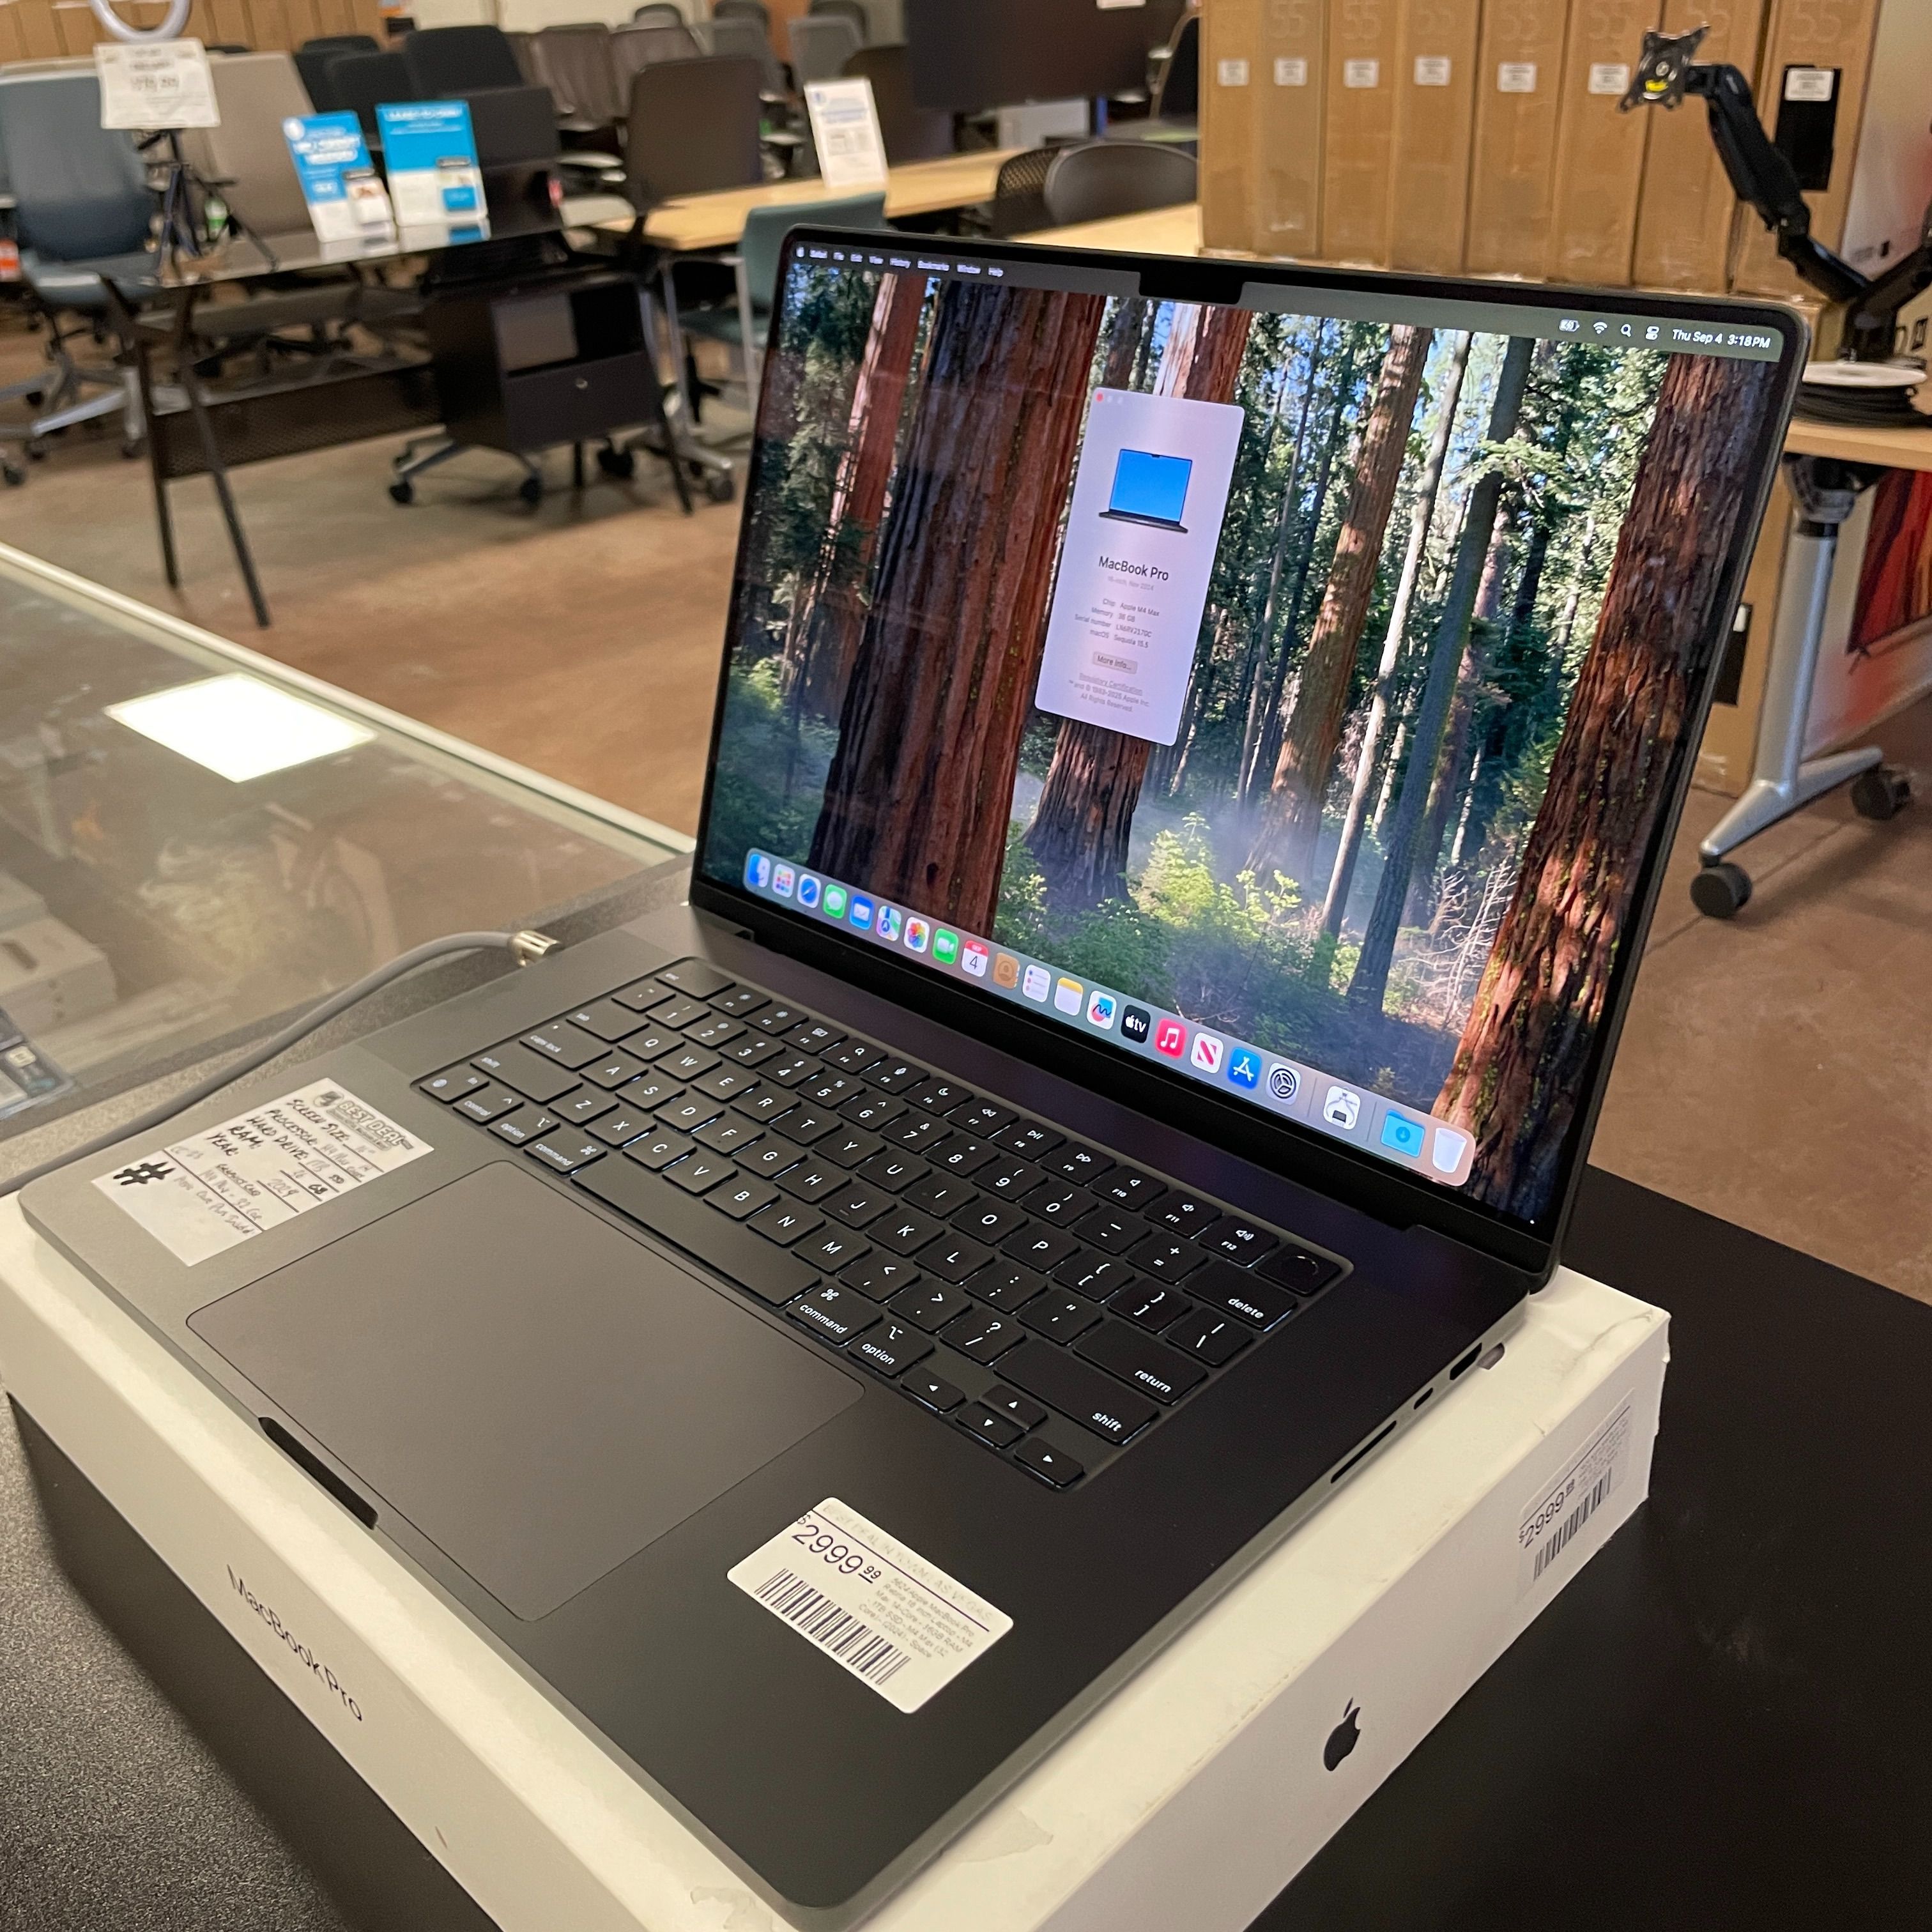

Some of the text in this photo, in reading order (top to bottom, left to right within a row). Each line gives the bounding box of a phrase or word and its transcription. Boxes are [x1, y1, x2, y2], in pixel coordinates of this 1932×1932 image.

[1672, 328, 1692, 342] Thu
[1692, 331, 1714, 345] Sep
[1714, 332, 1724, 344] 4
[1098, 556, 1169, 581] MacBook Pro
[1097, 655, 1114, 666] More
[969, 955, 977, 970] 4
[1134, 1018, 1147, 1033] tv
[645, 1038, 659, 1048] Q
[680, 1056, 698, 1066] W
[606, 1066, 620, 1075] A
[719, 1077, 734, 1086] E
[643, 1086, 659, 1095] S
[816, 1088, 832, 1096] 5
[575, 1100, 592, 1109] Z
[758, 1098, 773, 1107] R
[286, 1098, 325, 1124] SCREEN
[680, 1107, 696, 1116] D
[859, 1109, 873, 1118] 6
[246, 1116, 277, 1136] HARD
[337, 1100, 375, 1123] BEST
[365, 1119, 406, 1146] DEAL
[612, 1121, 630, 1131] X
[801, 1119, 816, 1128] T
[227, 1125, 263, 1147] RAM:
[500, 1123, 526, 1138] option
[903, 1130, 918, 1138] 7
[652, 1144, 668, 1153] C
[843, 1141, 858, 1151] Y
[535, 1143, 574, 1166] command
[762, 1151, 778, 1161] G
[948, 1154, 963, 1163] 8
[694, 1166, 710, 1176] V
[887, 1164, 903, 1174] U
[804, 1174, 823, 1186] H
[995, 1177, 1011, 1187] 9
[733, 1190, 750, 1201] B
[1112, 1188, 1127, 1197] F10
[850, 1201, 866, 1209] J
[1046, 1202, 1061, 1212] 0
[777, 1216, 796, 1227] N
[981, 1214, 997, 1225] O
[1165, 1214, 1180, 1223] F11
[896, 1225, 915, 1237] K
[822, 1241, 843, 1254] M
[1032, 1240, 1048, 1250] P
[1221, 1241, 1238, 1250] F12
[946, 1252, 959, 1263] L
[1227, 1298, 1264, 1319] delete
[799, 1305, 848, 1334] command
[861, 1343, 895, 1365] option
[1134, 1370, 1171, 1393] return
[863, 1565, 882, 1580] 99
[885, 1610, 903, 1625] SSD
[929, 1603, 960, 1627] MacBook
[960, 1624, 974, 1637] Pro
[227, 1564, 362, 1722] MacBook Pro
[943, 1637, 963, 1652] RAM
